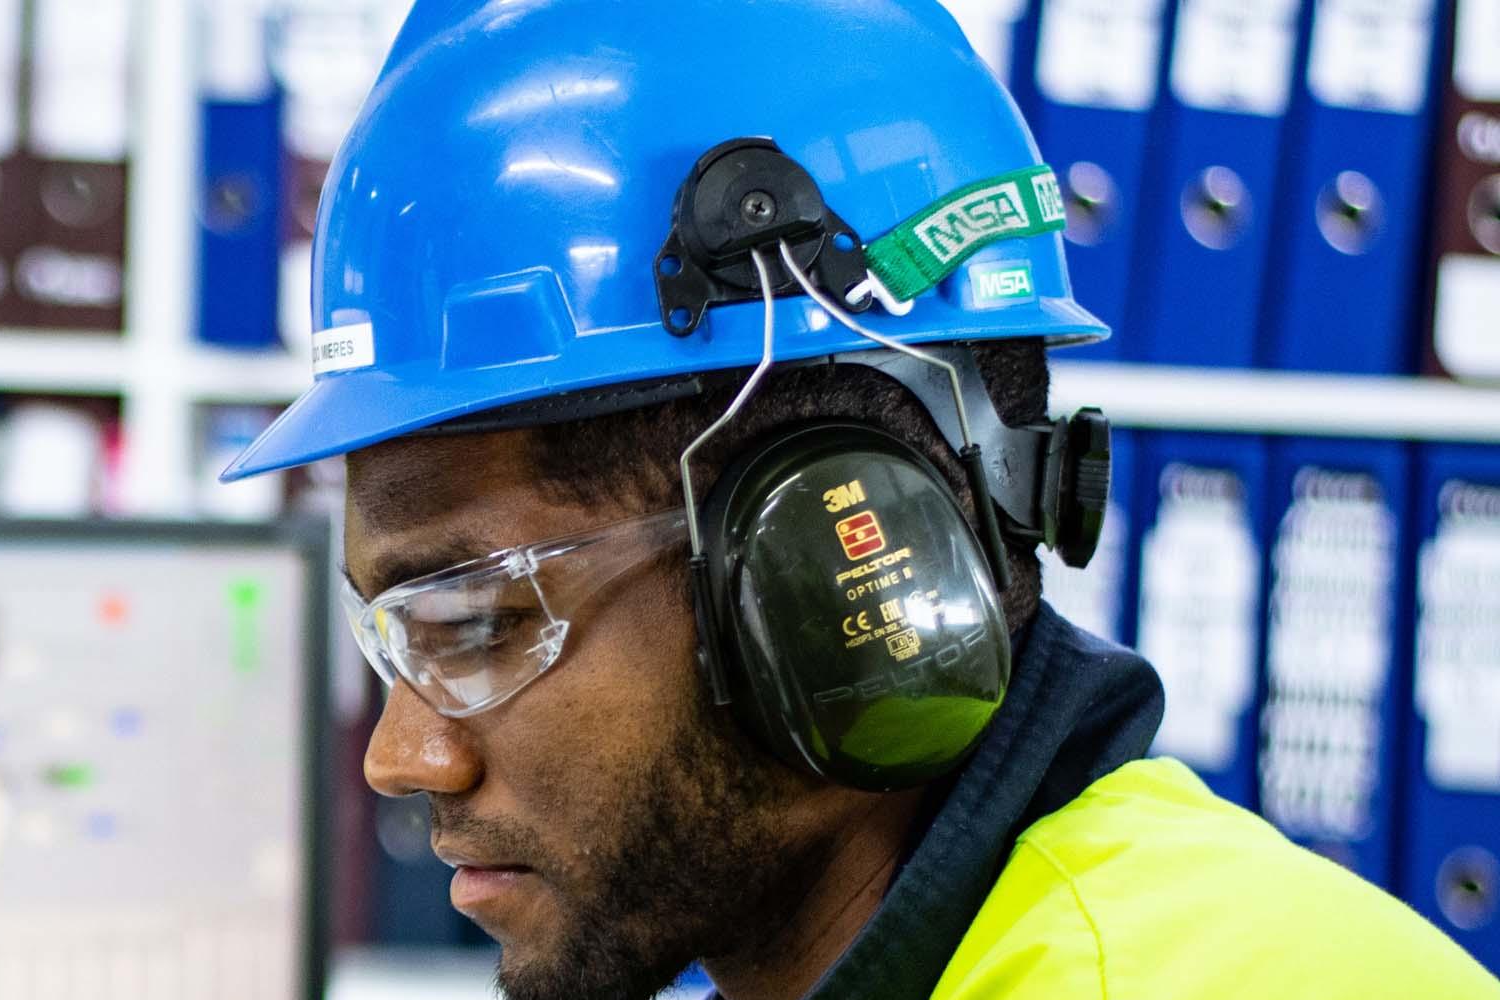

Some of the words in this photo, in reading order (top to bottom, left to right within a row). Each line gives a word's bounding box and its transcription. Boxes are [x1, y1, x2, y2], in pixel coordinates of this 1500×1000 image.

[925, 191, 1025, 257] MSA
[980, 270, 1030, 297] MSA
[822, 479, 867, 513] 3M
[835, 546, 913, 586] PELTOR
[846, 571, 900, 601] OPTIME
[842, 610, 872, 637] CE
